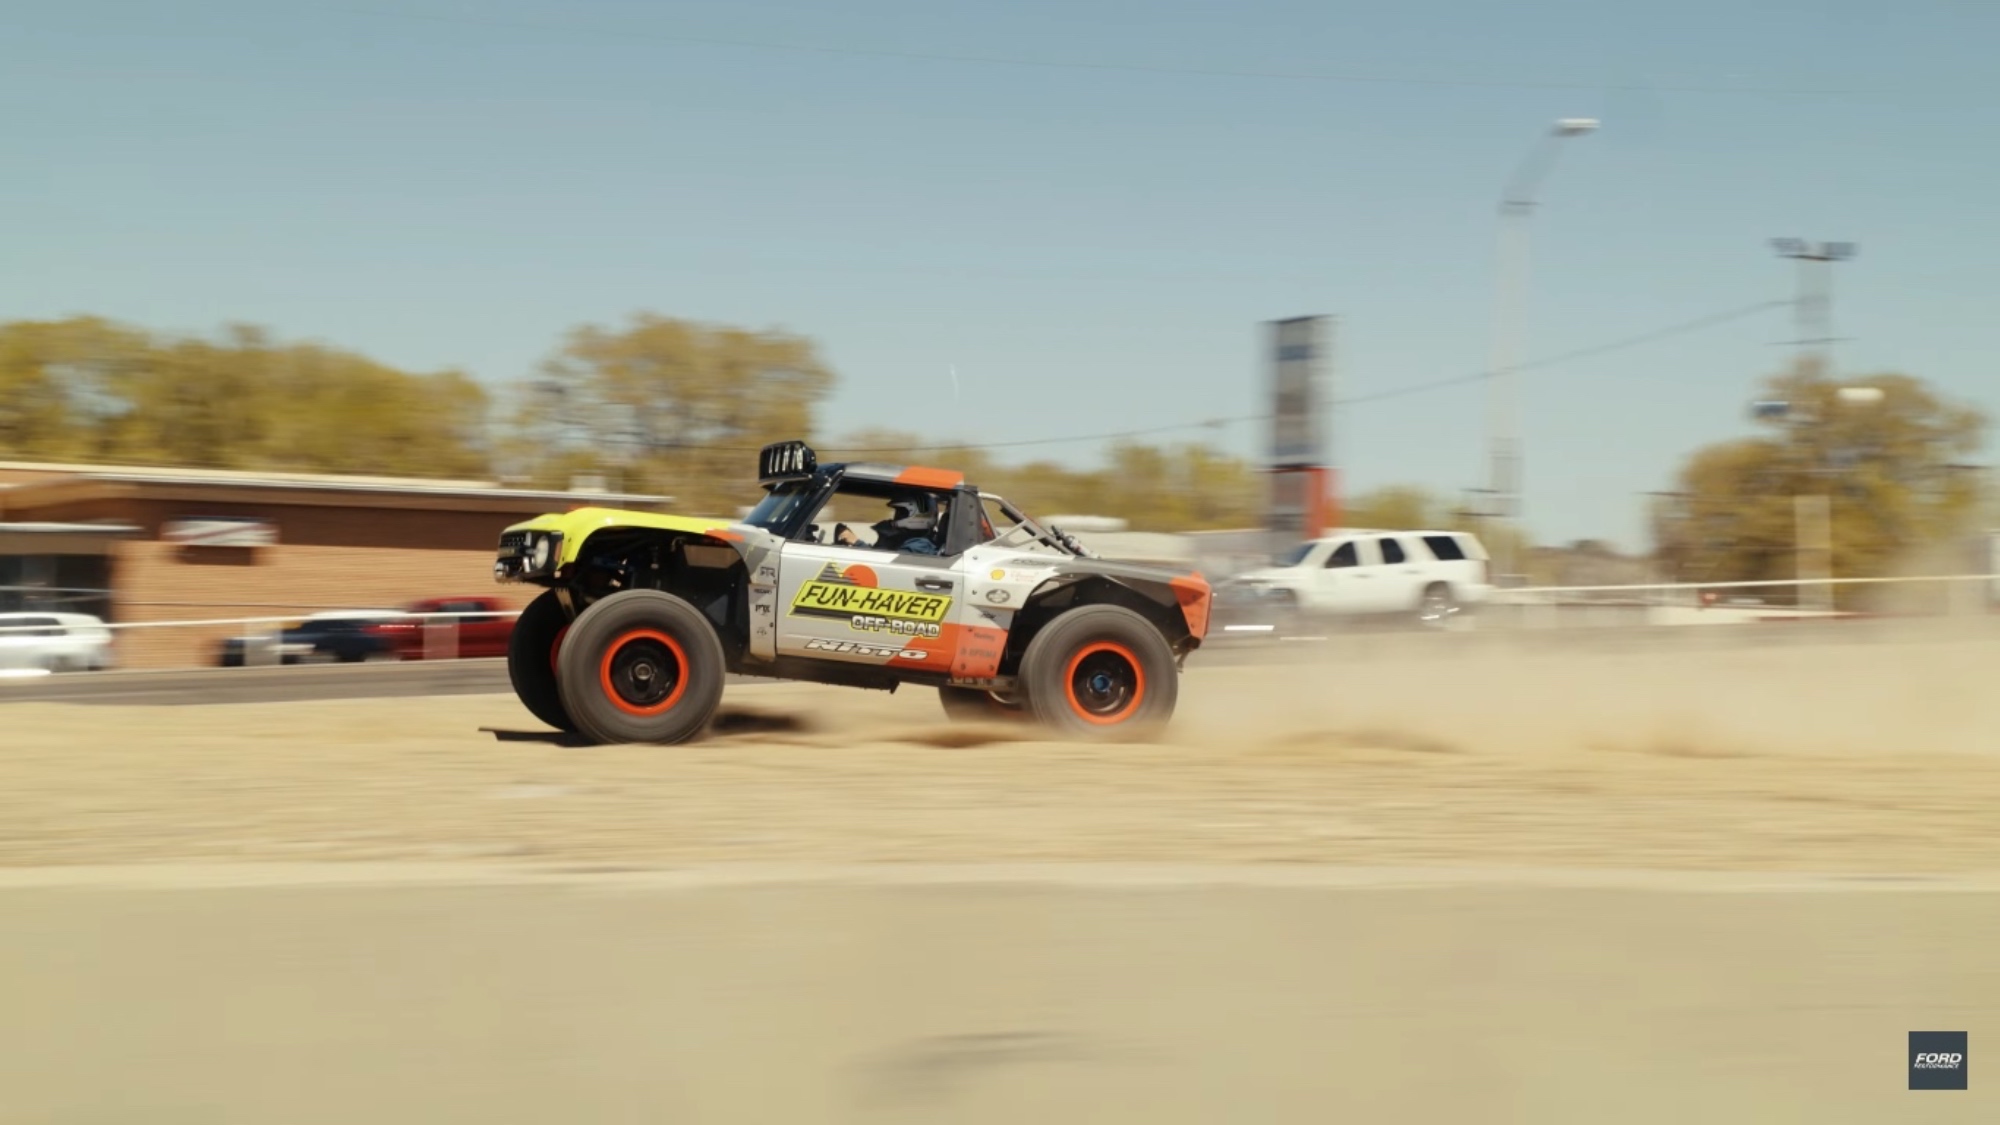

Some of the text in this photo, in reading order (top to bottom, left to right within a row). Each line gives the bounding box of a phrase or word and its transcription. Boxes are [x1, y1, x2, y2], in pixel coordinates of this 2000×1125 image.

[801, 585, 943, 617] FUN-HAVER
[851, 615, 941, 637] OFF-ROAD
[804, 638, 928, 660] NITTO
